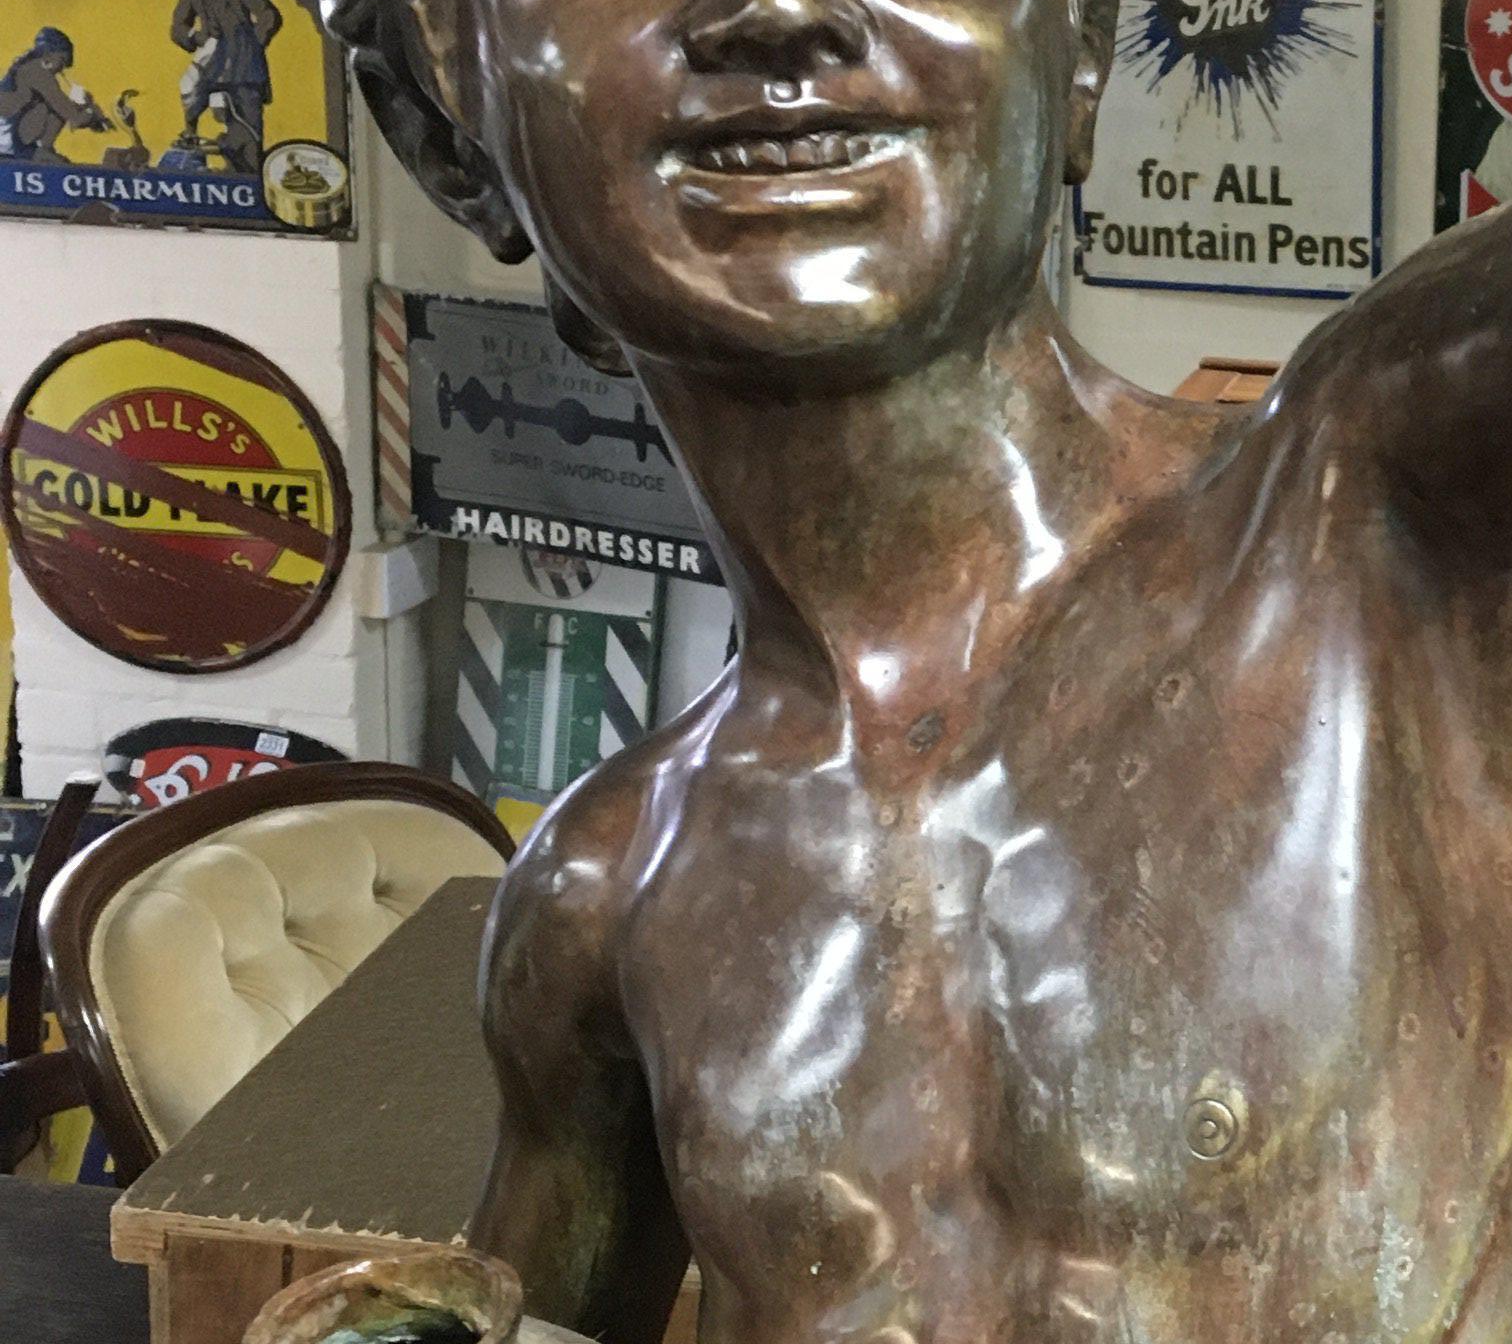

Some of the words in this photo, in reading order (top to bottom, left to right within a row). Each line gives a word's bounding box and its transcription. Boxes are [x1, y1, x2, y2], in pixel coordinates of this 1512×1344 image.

[13, 171, 45, 196] IS
[62, 174, 256, 208] CHARMING
[1138, 158, 1199, 201] for
[1213, 163, 1293, 207] ALL
[1083, 212, 1256, 263] Fountain
[1267, 223, 1371, 269] Pens
[455, 506, 701, 574] HAIRDRESSER
